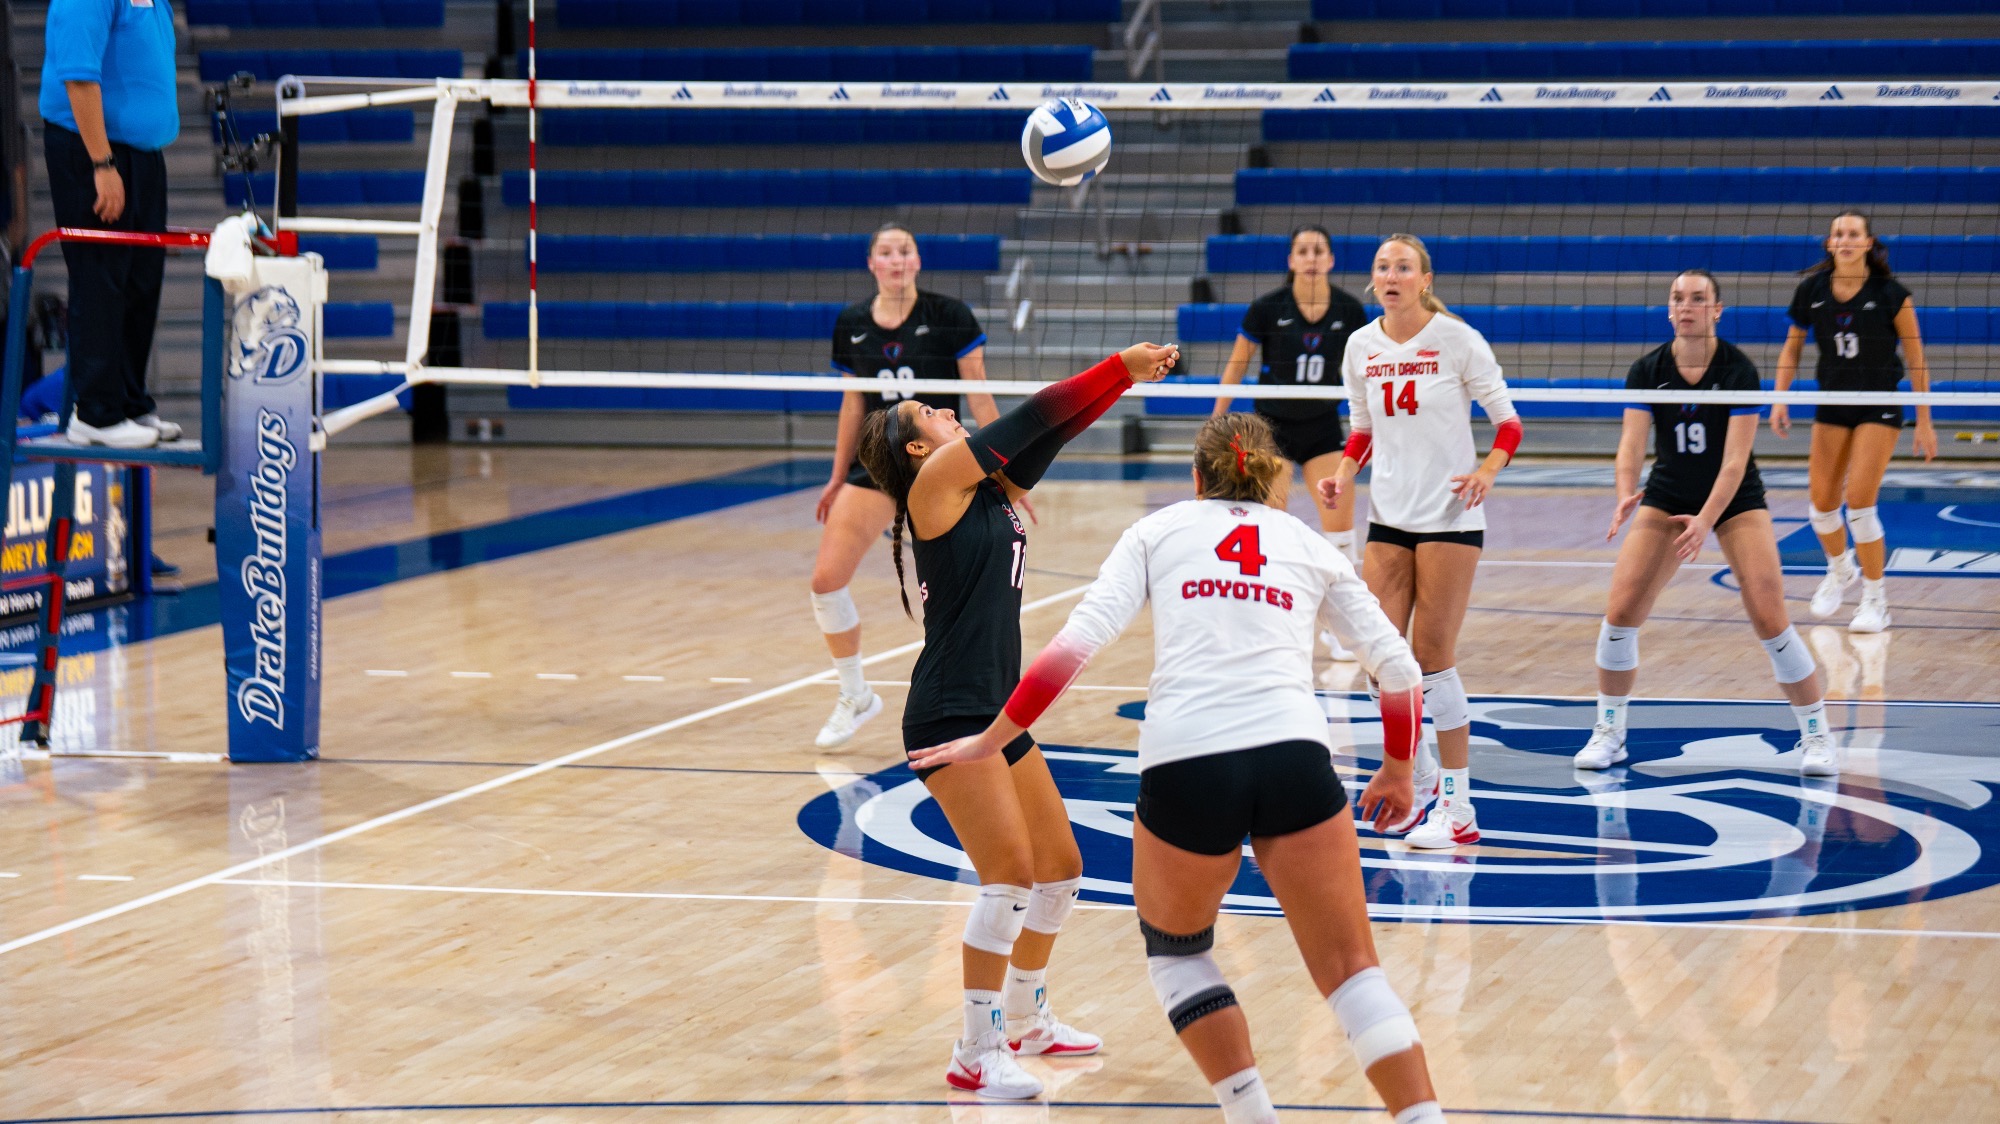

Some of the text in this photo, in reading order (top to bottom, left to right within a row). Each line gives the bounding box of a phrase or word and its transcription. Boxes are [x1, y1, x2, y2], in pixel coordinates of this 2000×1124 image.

[1535, 87, 1617, 101] DrakeBulldogs
[1704, 86, 1788, 100] DrakeBulldogs
[1875, 85, 1960, 99] DrakeBulldogs
[1833, 332, 1859, 359] 13
[1296, 354, 1325, 383] 10
[1365, 361, 1439, 378] SOUTH DAKOTA
[1381, 380, 1419, 417] 14
[1674, 422, 1707, 454] 19
[1214, 524, 1267, 577] 4
[237, 406, 297, 731] DrakeBulldogs
[1181, 578, 1294, 612] COYOTES
